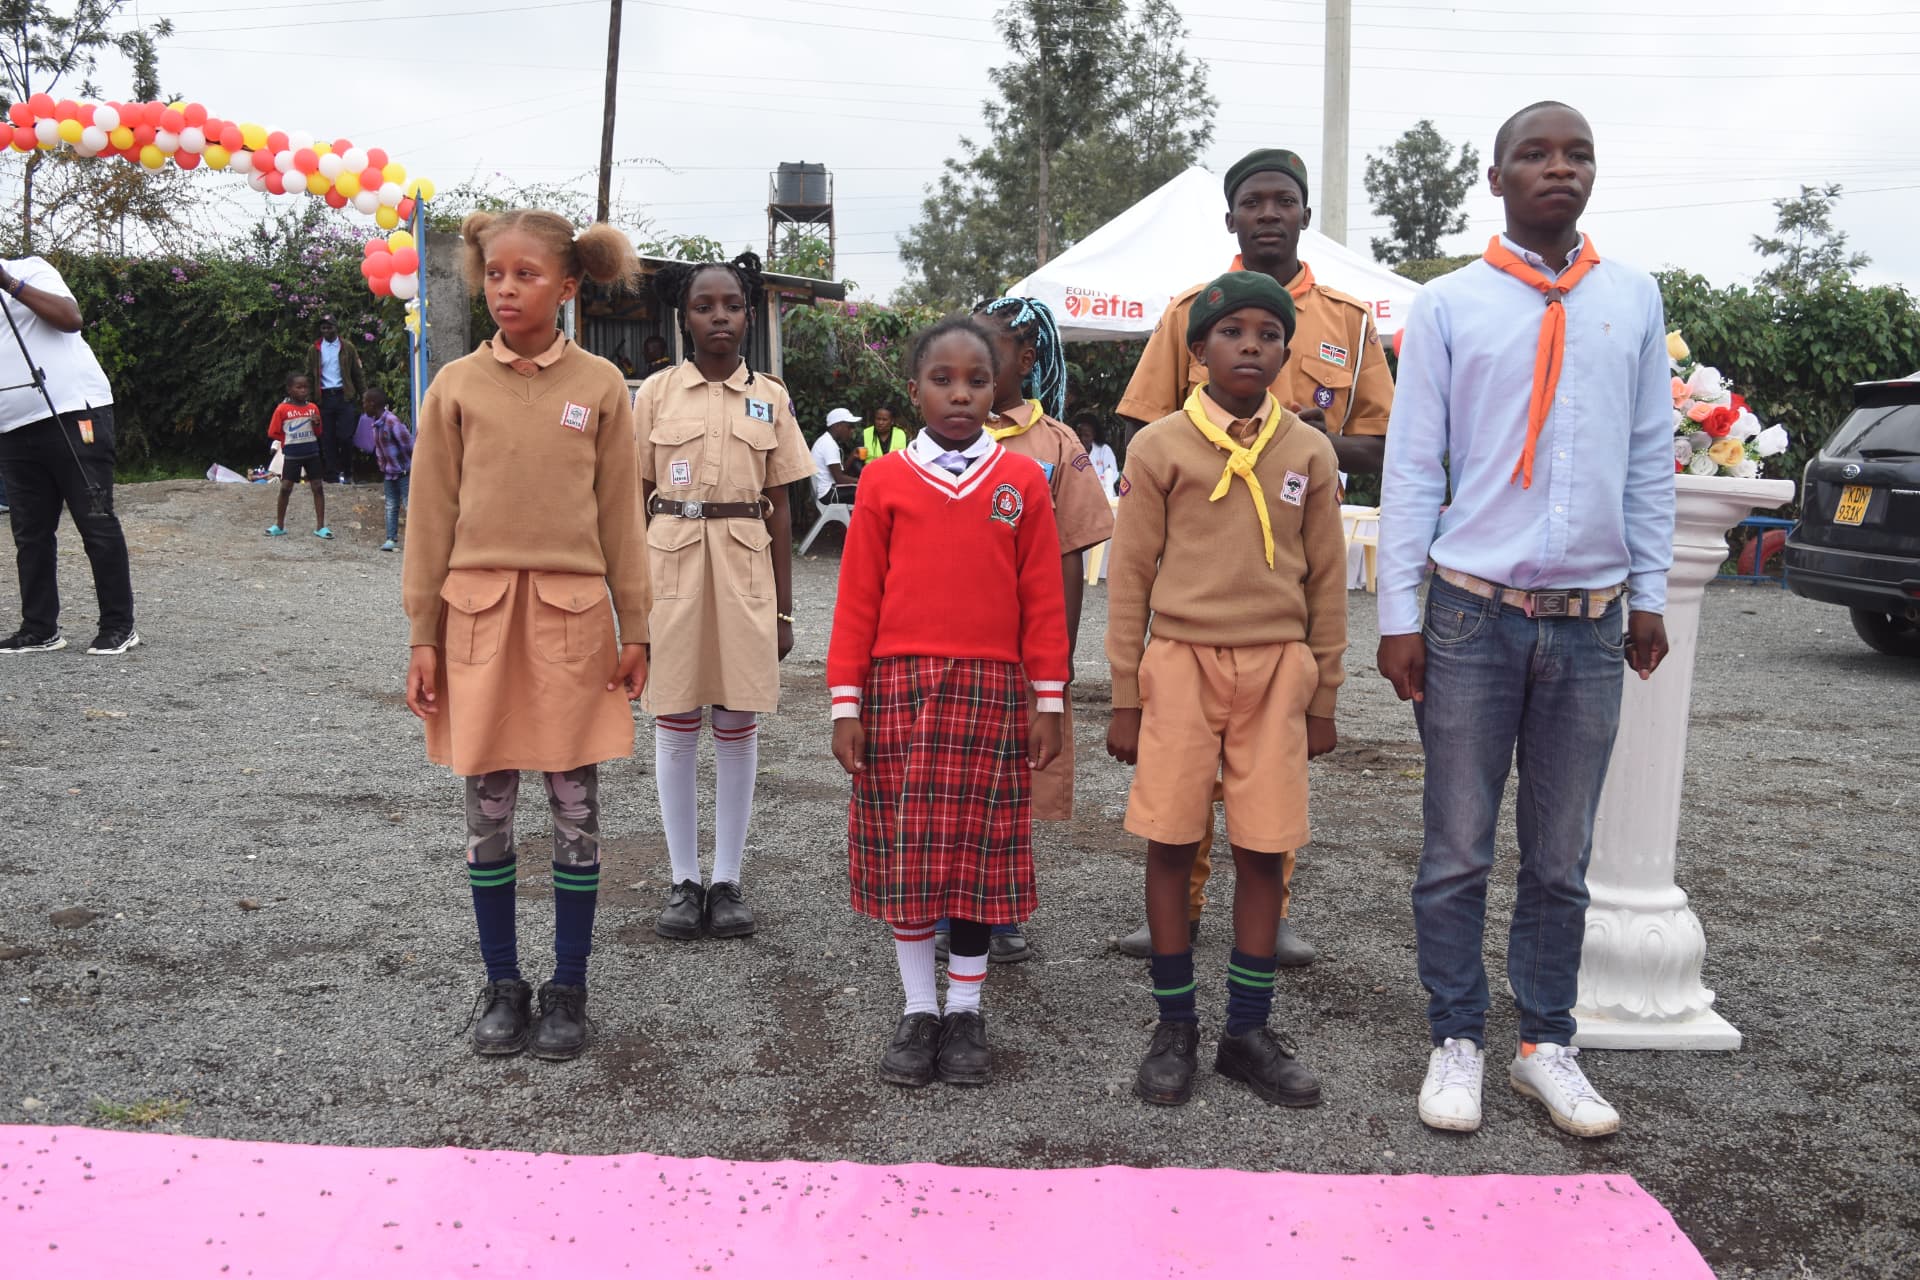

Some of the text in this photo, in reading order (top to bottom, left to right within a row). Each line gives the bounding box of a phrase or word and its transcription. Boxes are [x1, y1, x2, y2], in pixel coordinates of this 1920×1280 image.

[1092, 294, 1143, 318] afia
[1848, 487, 1869, 504] KDN
[1838, 504, 1863, 521] 931K
